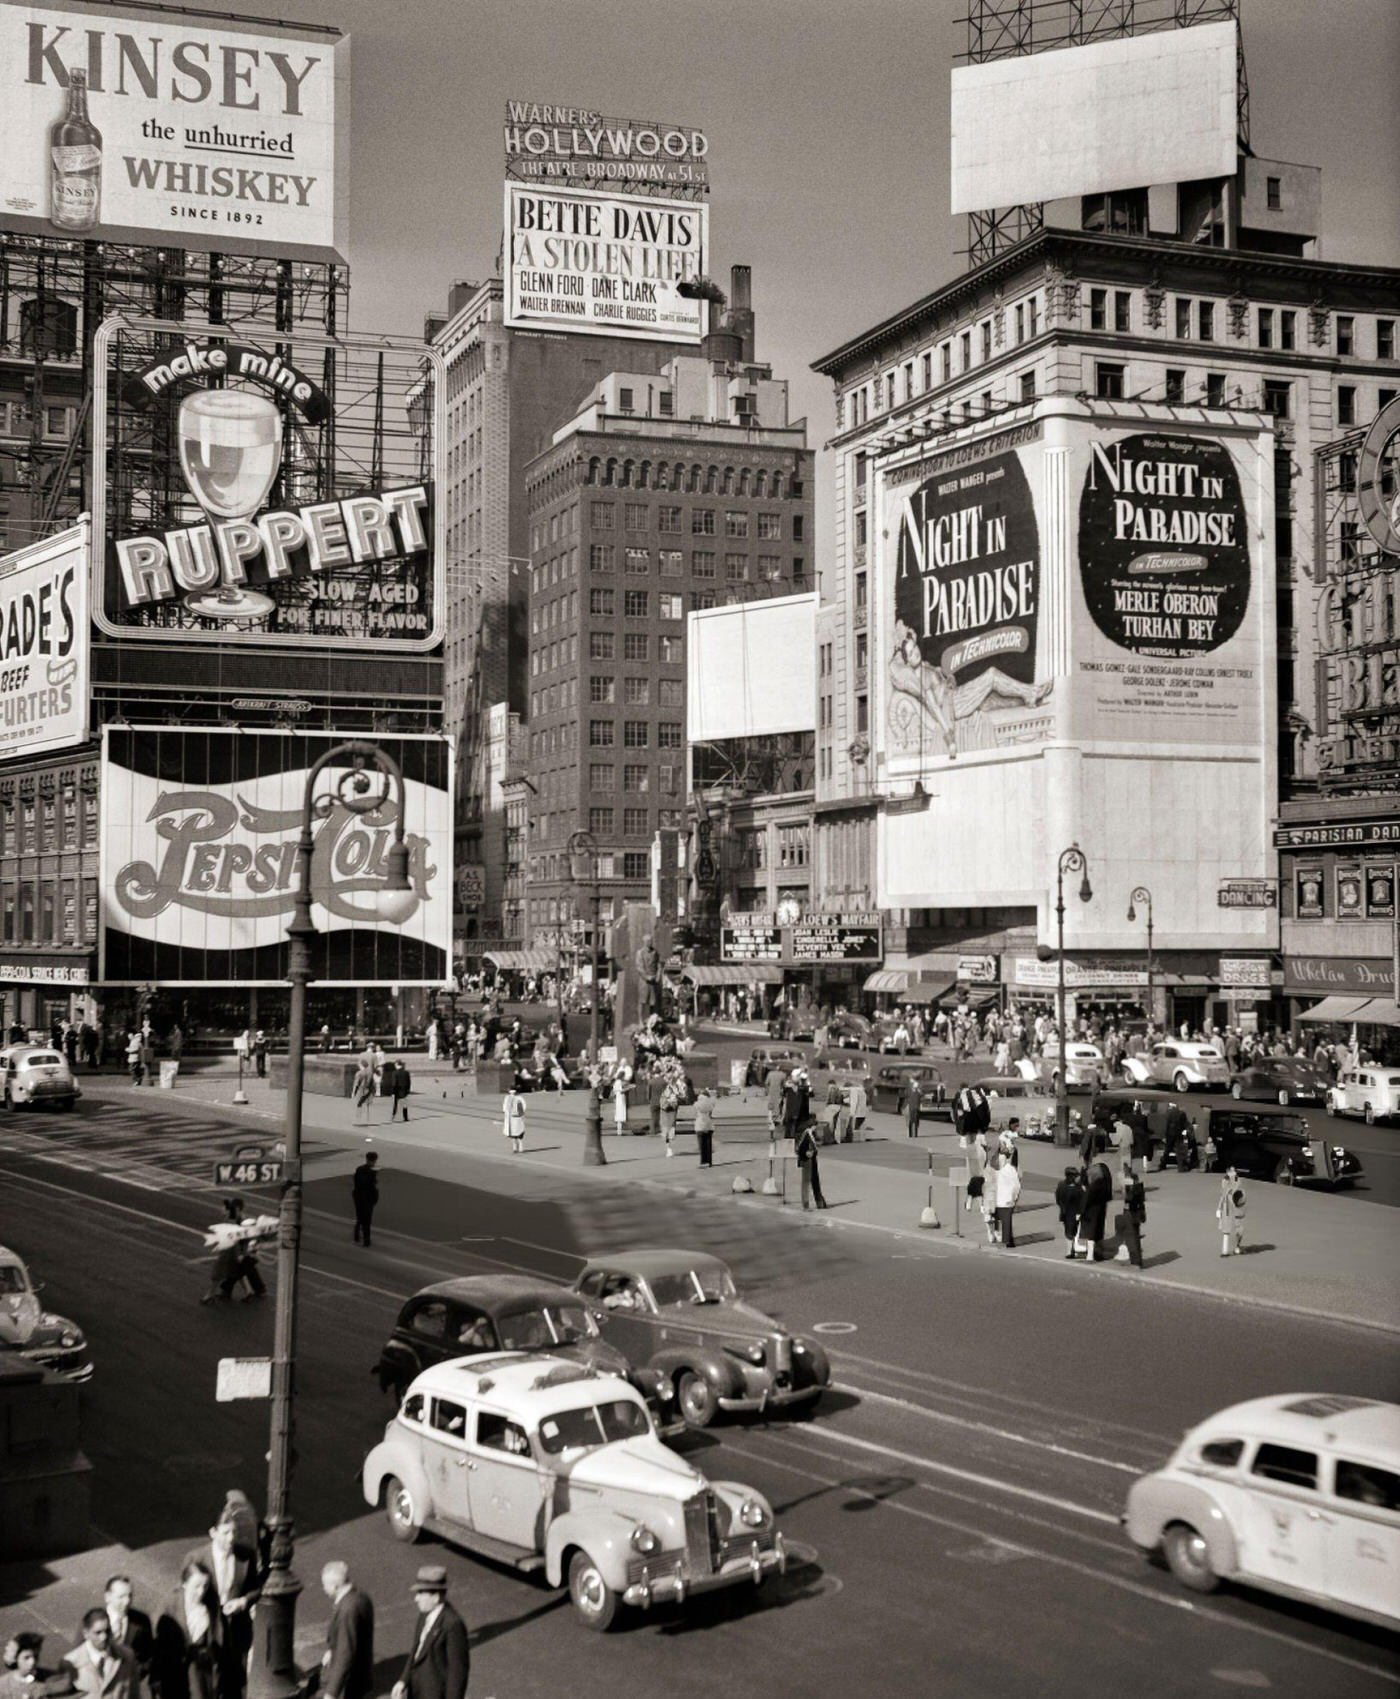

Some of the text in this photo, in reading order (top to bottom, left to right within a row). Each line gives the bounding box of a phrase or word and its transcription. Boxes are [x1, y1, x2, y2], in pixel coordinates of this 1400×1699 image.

[25, 22, 321, 116] KINSEY
[141, 118, 294, 153] the unhurried
[505, 127, 708, 156] HOLLYWOOD
[123, 155, 317, 207] WHISKEY
[521, 161, 579, 176] THEATRE
[587, 162, 665, 179] BROADWAY
[679, 165, 692, 181] 51
[171, 206, 263, 224] SINCE 1892
[518, 197, 692, 246] BETTE DAVIS
[544, 237, 633, 276] STOLEN
[520, 271, 657, 303] GLENN FORD DANE CLARK
[520, 296, 657, 322] WALTER BRENNAN CHARLIE RUGGLES
[142, 345, 227, 394] make
[240, 351, 312, 400] mine
[989, 425, 1040, 453] CRITERION
[938, 481, 958, 496] WALTER
[960, 472, 984, 489] WANGER
[1089, 441, 1224, 499] NIGHT IN
[901, 489, 1006, 578] NIGHT IN
[1114, 499, 1236, 547] PARADISE
[115, 486, 428, 605] RUPPERT
[1146, 554, 1202, 569] TECHNICOLOR
[0, 566, 74, 661] ADE'S
[922, 561, 1034, 638] PARADISE
[1114, 590, 1218, 616] MERLE OBERON
[278, 607, 427, 630] FOR FINER FLAVOR
[1123, 616, 1216, 640] TURHAN BEY
[950, 631, 1021, 670] IN TECHNICOLOR
[1, 665, 29, 693] BEEF
[1080, 662, 1103, 671] THOMAS
[1105, 663, 1125, 672] GOMEZ
[0, 683, 72, 726] URTERS
[1304, 827, 1363, 843] PARISIAN
[461, 881, 483, 893] BECK
[1221, 891, 1273, 905] DANCING
[804, 914, 879, 926] LOEW'S MAYFAIR
[1224, 972, 1267, 983] DRUGS
[1292, 961, 1345, 981] Whelan
[235, 1164, 257, 1182] 46
[261, 1163, 281, 1181] ST
